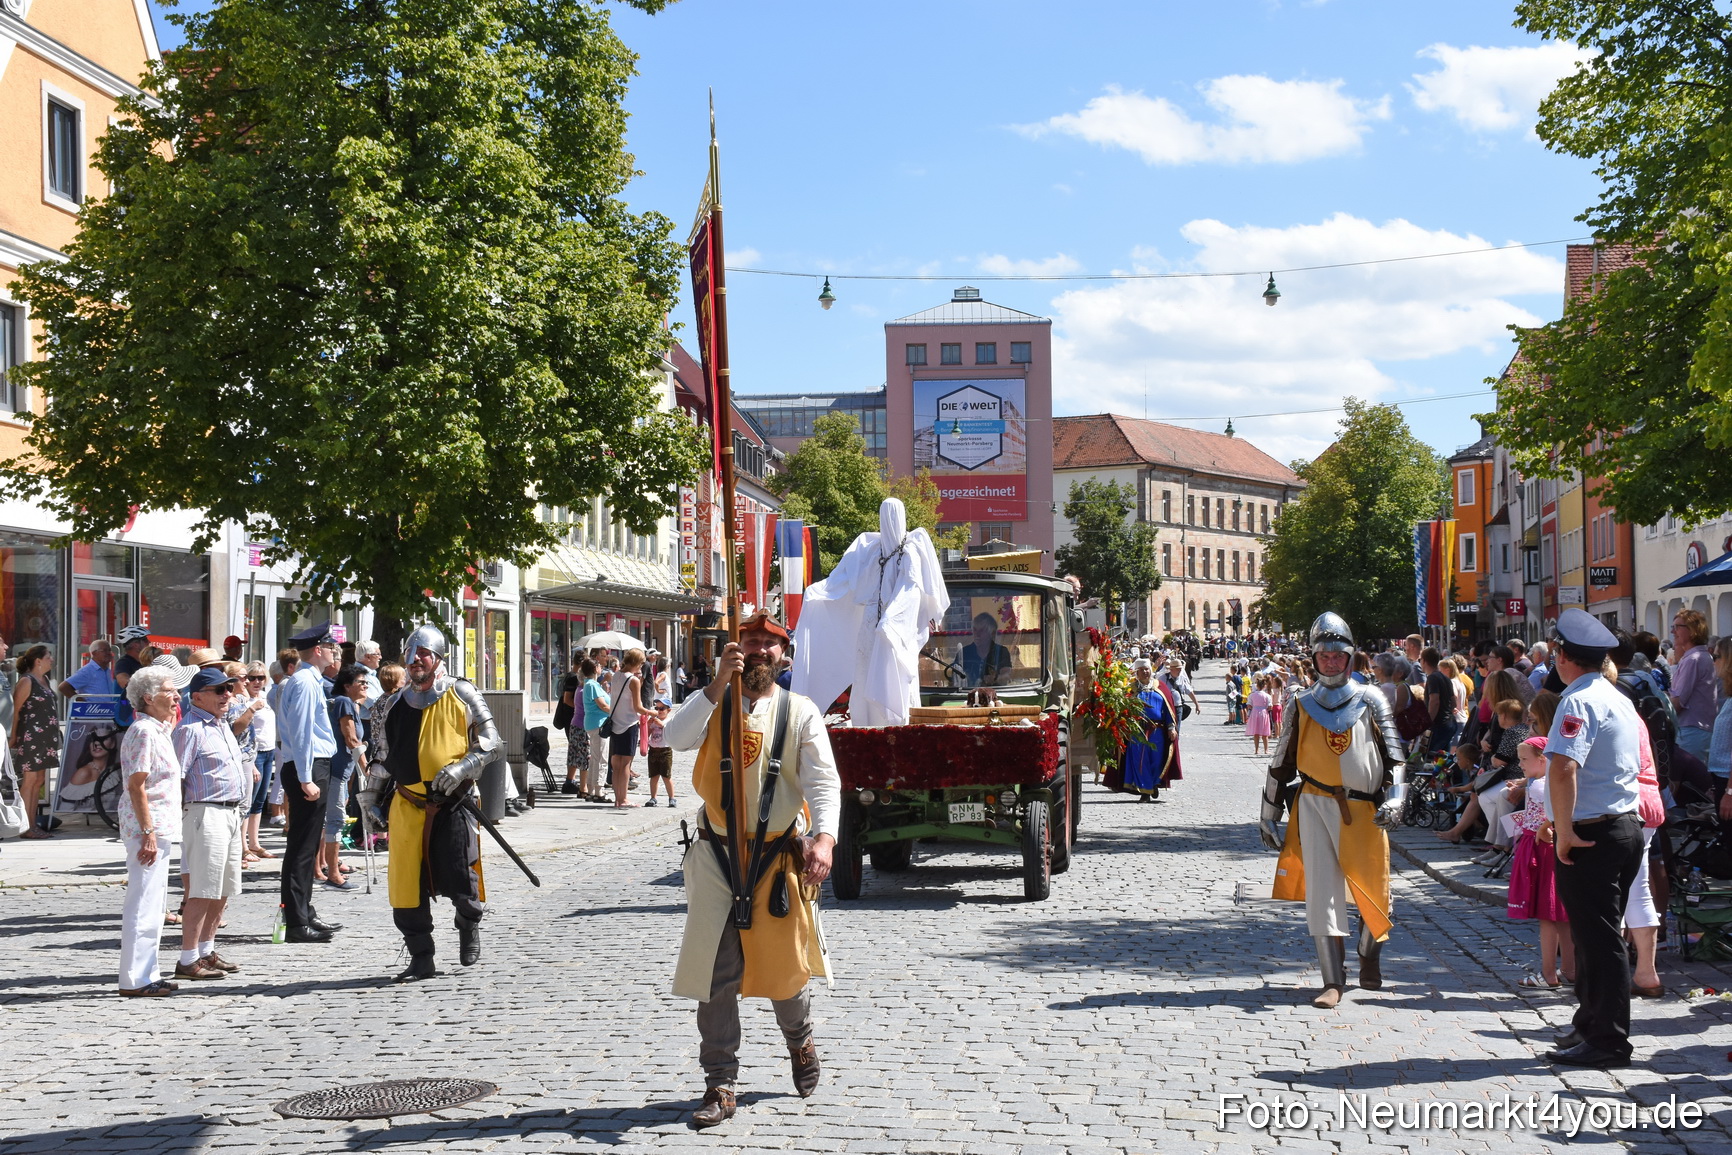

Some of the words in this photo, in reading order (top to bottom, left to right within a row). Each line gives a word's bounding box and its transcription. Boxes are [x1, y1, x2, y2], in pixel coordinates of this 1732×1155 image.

[941, 402, 958, 411] DIE
[1591, 568, 1615, 577] MATT
[958, 804, 975, 813] NM
[952, 812, 965, 821] RP
[970, 811, 982, 820] 83
